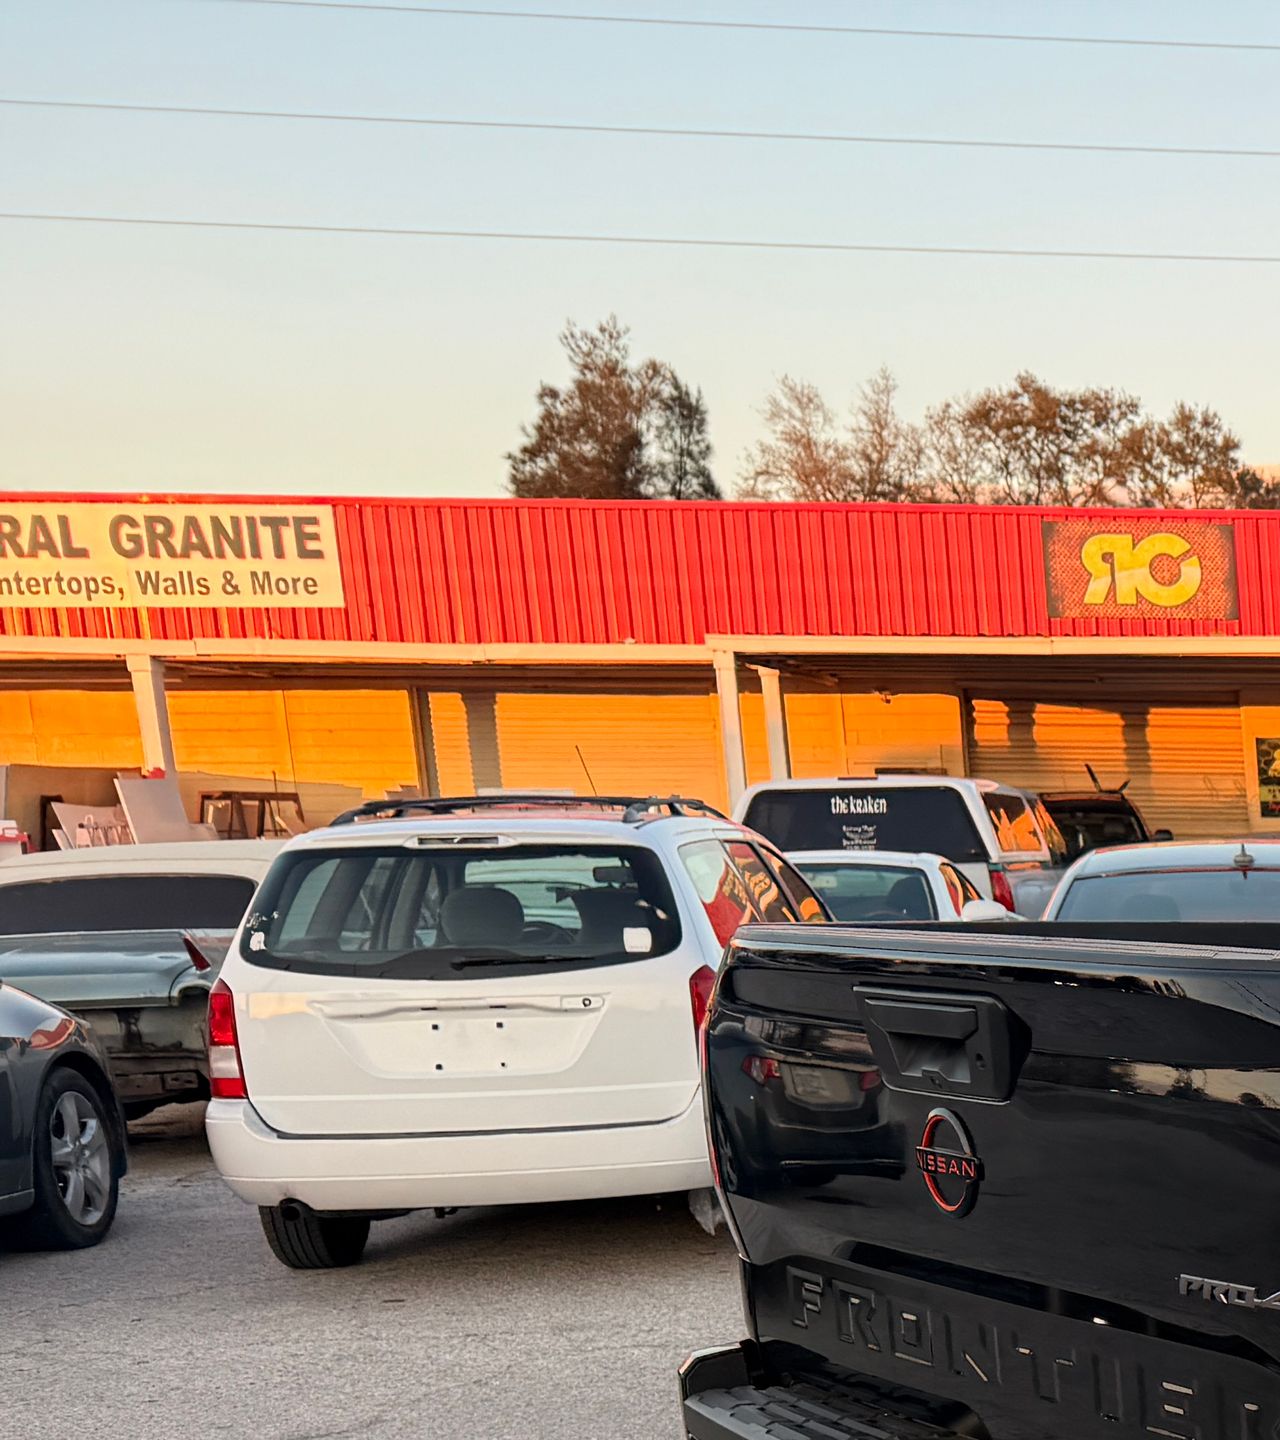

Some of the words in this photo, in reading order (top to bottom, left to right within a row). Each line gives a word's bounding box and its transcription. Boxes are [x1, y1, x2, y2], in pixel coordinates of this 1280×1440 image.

[0, 514, 90, 559] RAL
[108, 513, 325, 559] GRANITE
[0, 570, 125, 602] ntertops,
[135, 569, 211, 596] Walls
[221, 570, 241, 596] &
[249, 570, 319, 596] More
[916, 1149, 976, 1178] NISSAN
